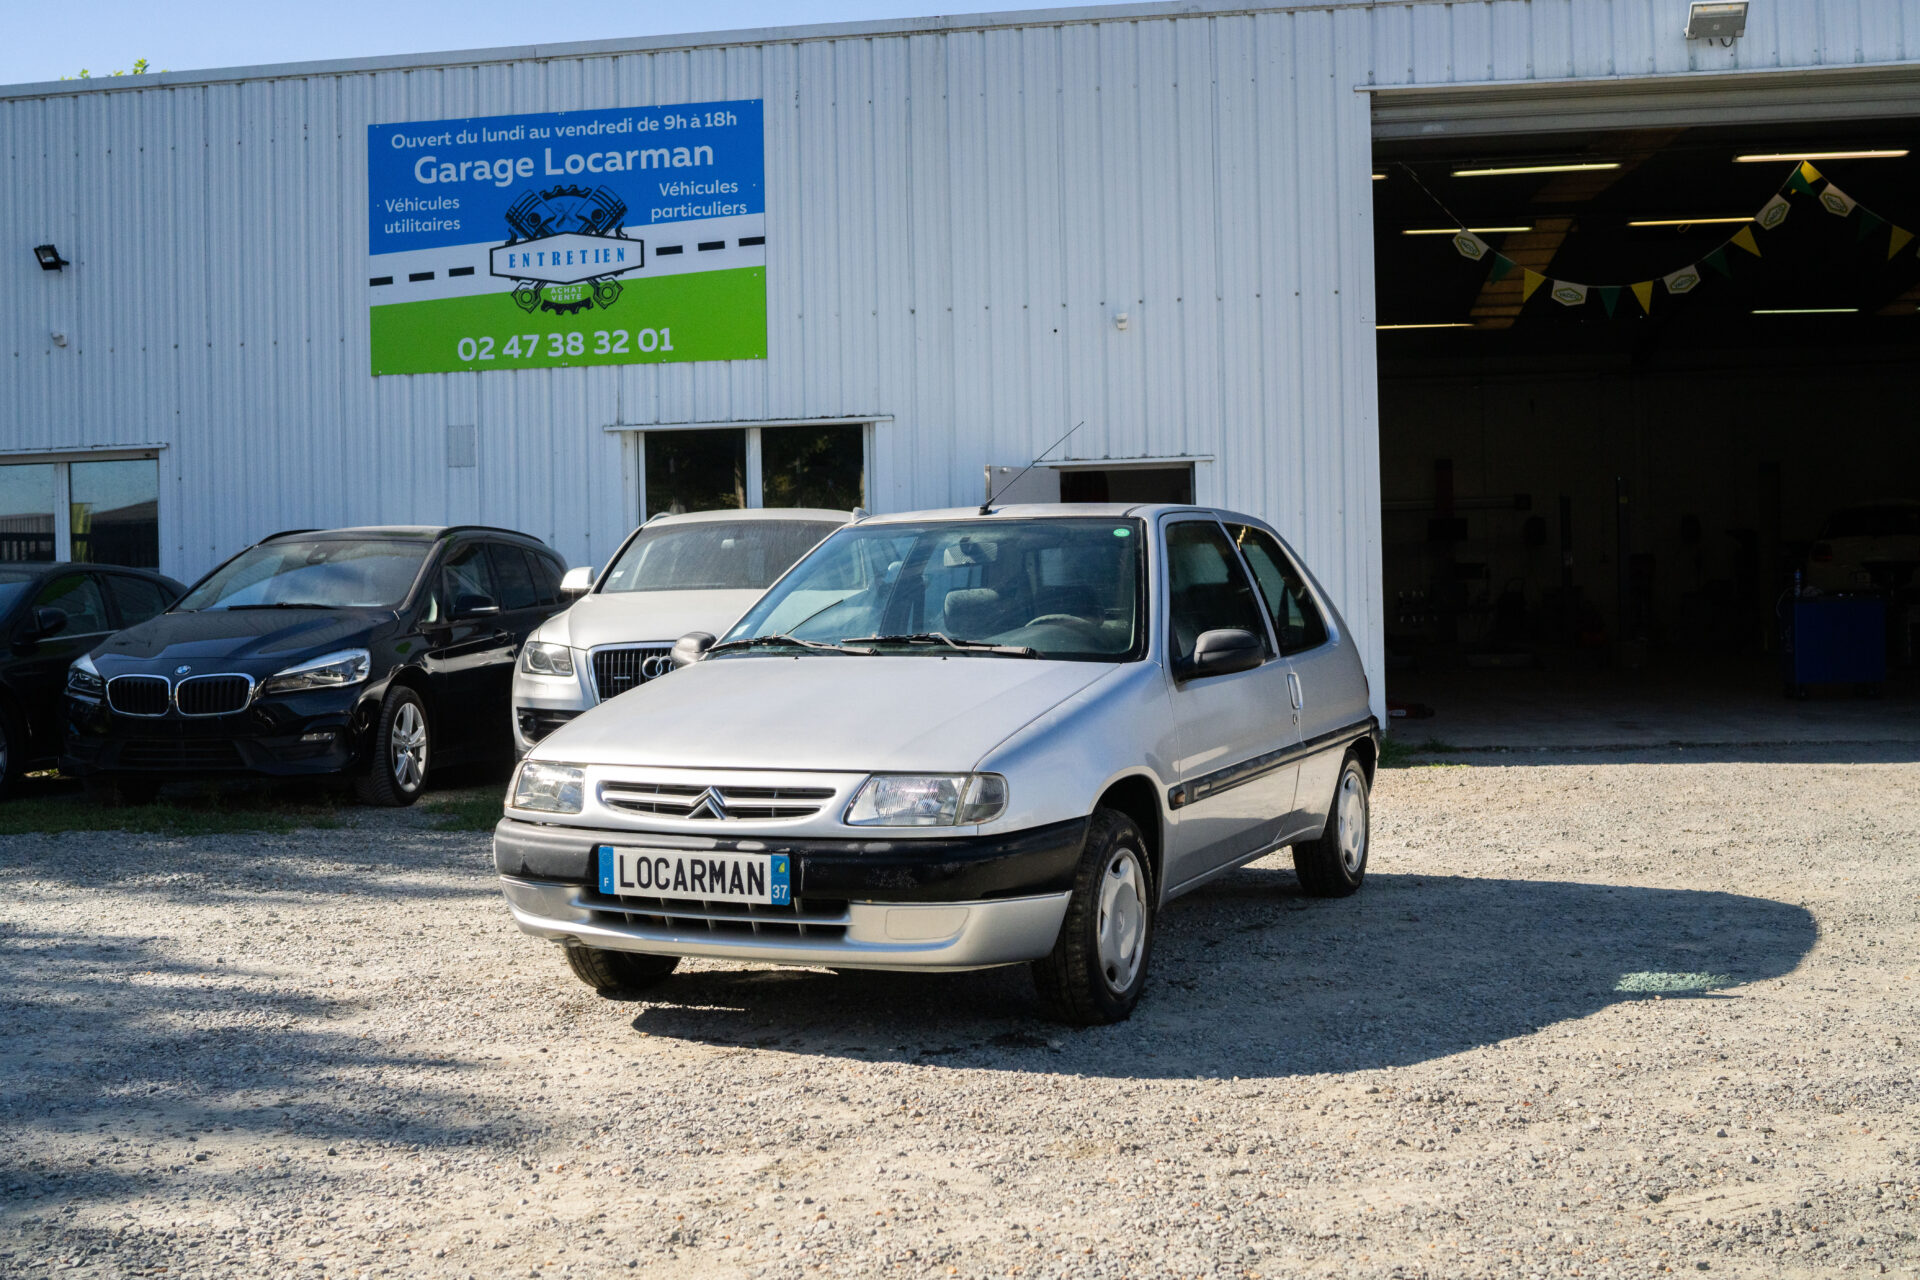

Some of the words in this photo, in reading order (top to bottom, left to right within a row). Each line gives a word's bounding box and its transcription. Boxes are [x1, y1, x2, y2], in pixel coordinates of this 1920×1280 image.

[391, 131, 452, 149] Ouvert
[455, 129, 478, 145] du
[482, 125, 525, 143] lundi
[529, 126, 550, 140] au
[555, 117, 633, 137] vendredi
[637, 116, 660, 132] de
[663, 114, 687, 131] 9h
[690, 113, 702, 129] à
[704, 111, 737, 128] 18h
[414, 155, 535, 188] Garage
[544, 144, 714, 176] Locarman
[659, 179, 739, 197] Véhicules
[384, 195, 460, 213] Véhicules
[651, 200, 748, 223] particuliers
[384, 217, 461, 234] utilitaires
[508, 247, 625, 269] ENTRETIEN
[551, 286, 582, 294] ACHAT
[551, 293, 582, 301] VENTE
[457, 336, 495, 361] 02
[502, 334, 540, 358] 47
[547, 332, 585, 357] 38
[593, 329, 630, 354] 32
[637, 328, 674, 352] 01
[603, 877, 609, 887] F
[619, 854, 765, 896] LOCARMAN
[772, 884, 788, 899] 37
